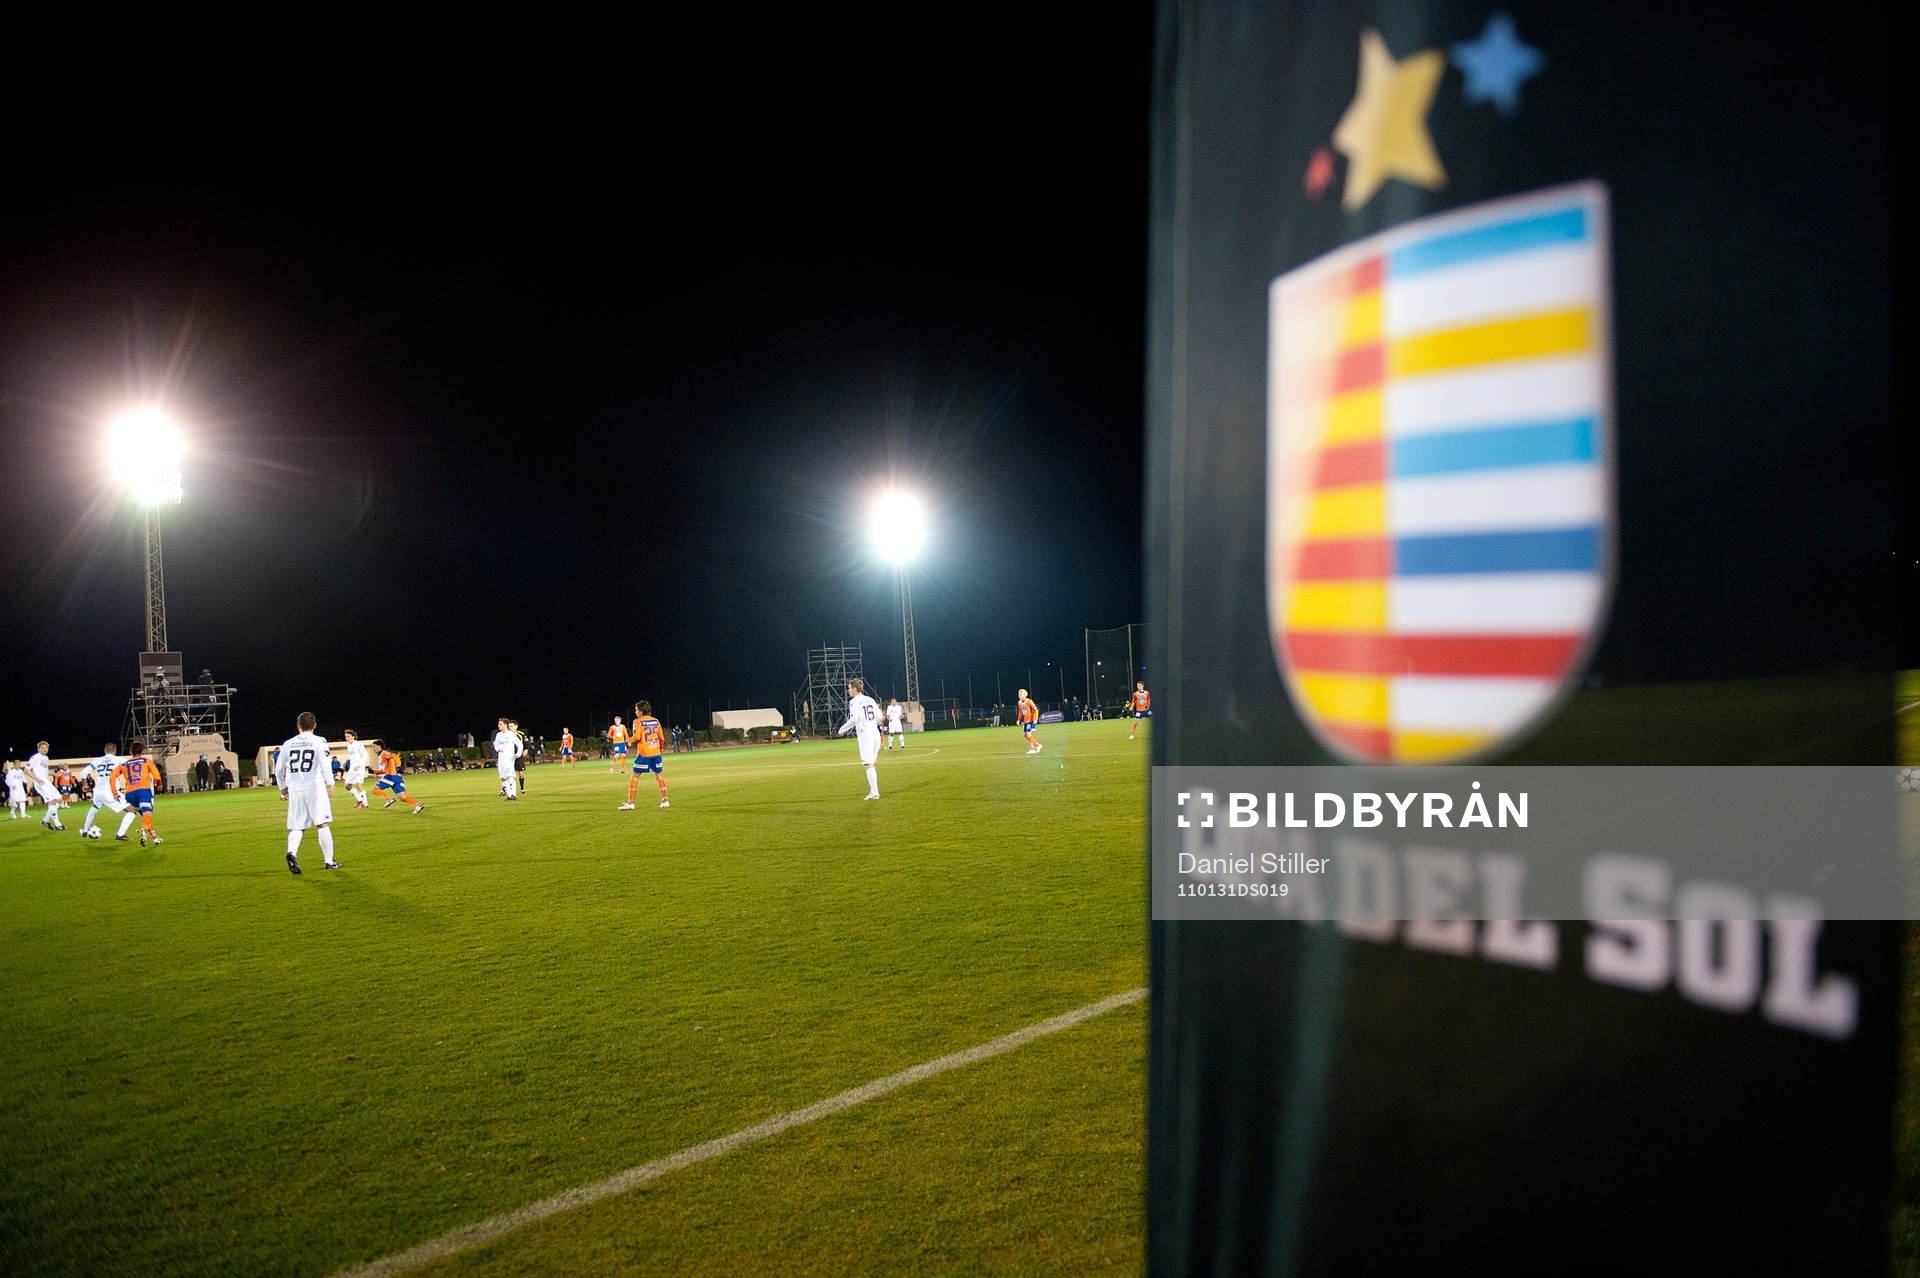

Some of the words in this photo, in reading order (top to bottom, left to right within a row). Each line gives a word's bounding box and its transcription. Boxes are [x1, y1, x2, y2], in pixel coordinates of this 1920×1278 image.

[862, 704, 875, 721] 16
[127, 762, 143, 782] 19
[289, 749, 315, 773] 28
[1335, 836, 1559, 971] DEL
[1581, 851, 1858, 1040] SOL
